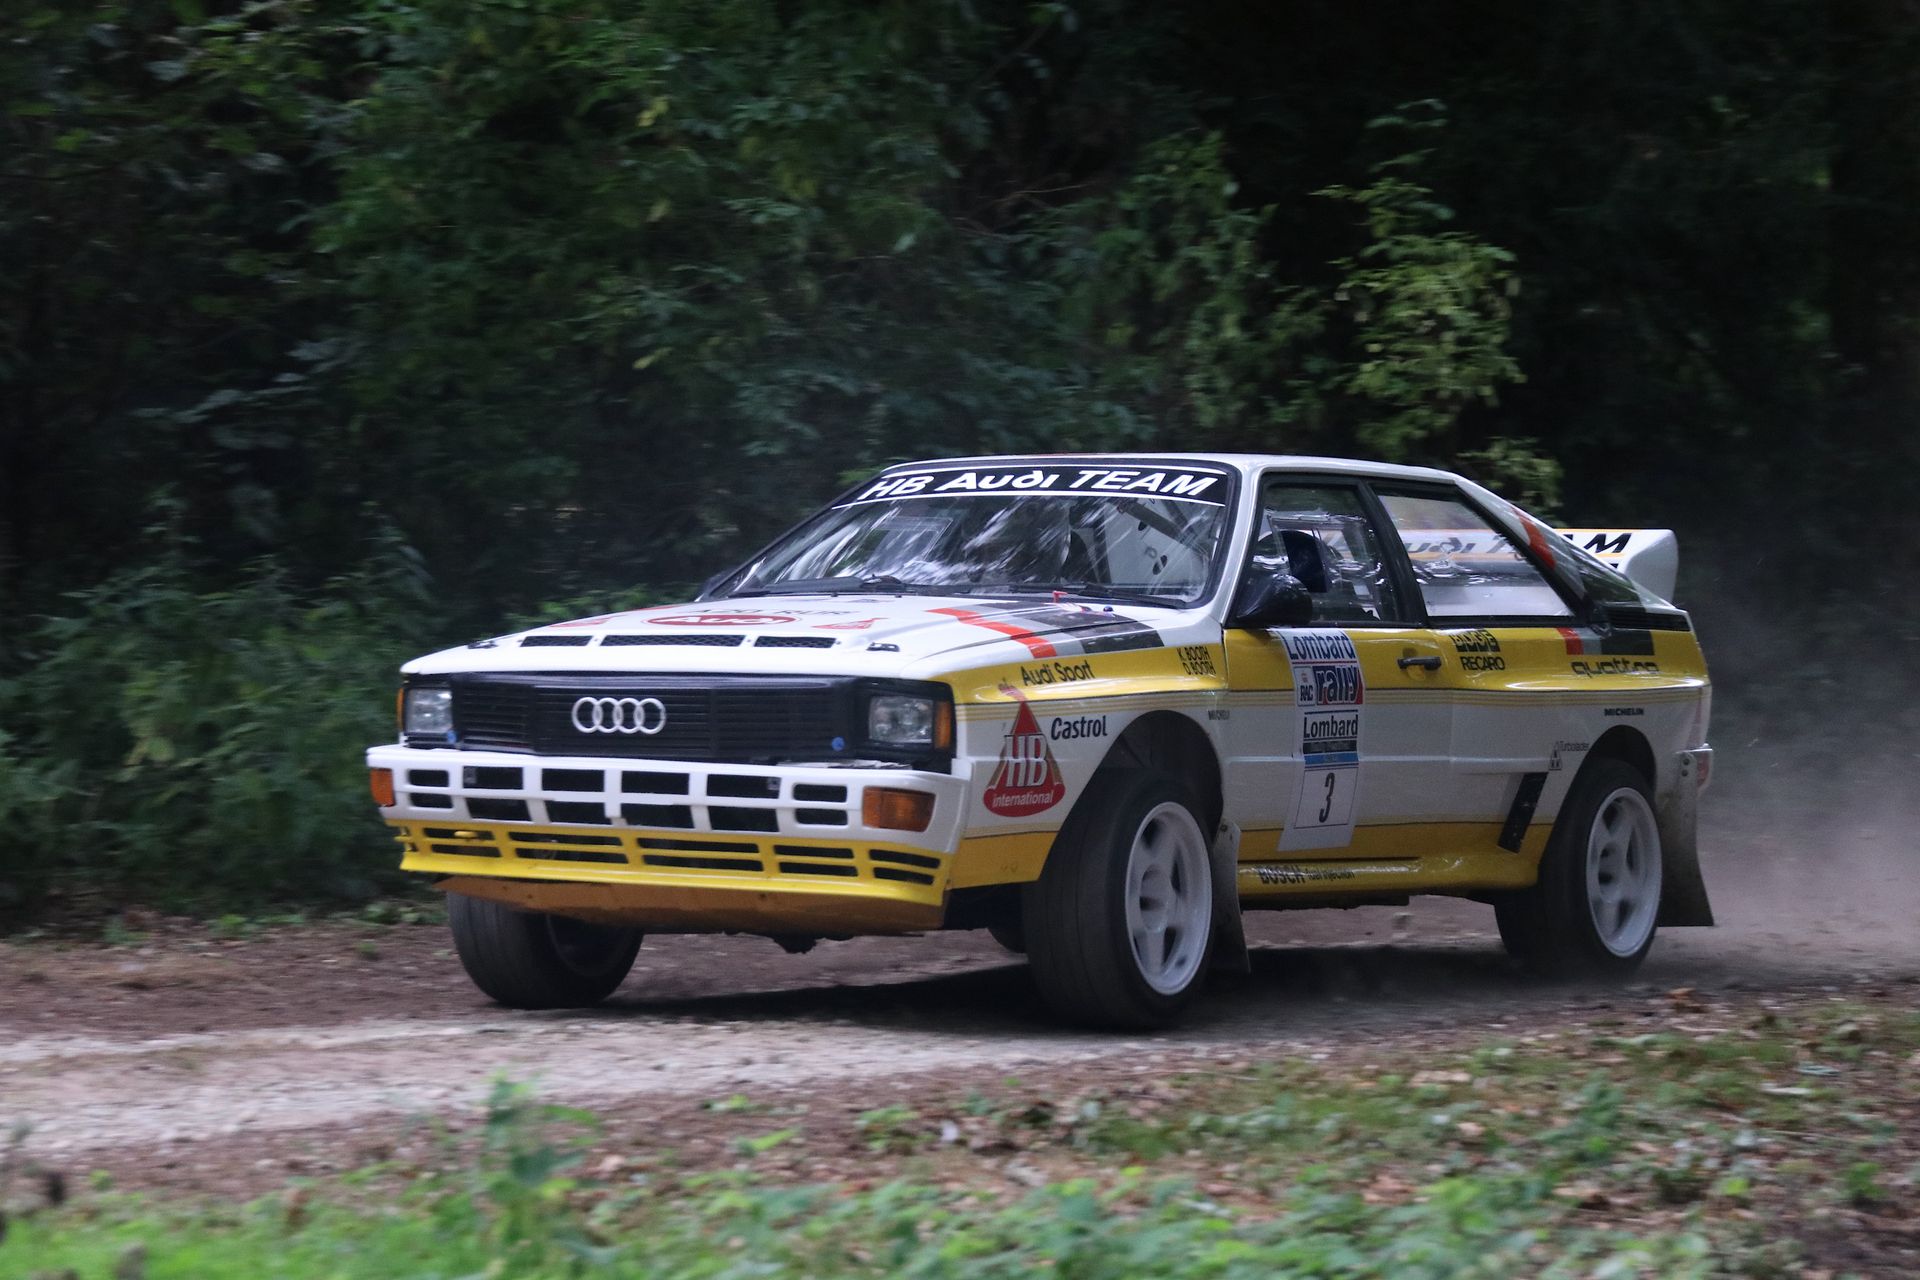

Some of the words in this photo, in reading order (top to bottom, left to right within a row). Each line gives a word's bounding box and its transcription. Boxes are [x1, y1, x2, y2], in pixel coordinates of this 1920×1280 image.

[857, 475, 936, 500] HB
[1069, 470, 1218, 496] TEAM
[1284, 630, 1356, 661] Lombard
[1021, 663, 1055, 686] Audi
[1054, 660, 1096, 682] Sport
[1460, 656, 1506, 671] RECARO
[1570, 657, 1660, 678] quattro
[1300, 684, 1314, 702] RAC
[1315, 665, 1359, 702] rally
[1604, 708, 1645, 717] MICHELIN
[1051, 715, 1108, 740] Castrol
[1303, 714, 1359, 738] Lombard
[1004, 734, 1049, 787] HB
[992, 789, 1054, 808] international
[1318, 772, 1336, 823] 3
[1258, 865, 1306, 885] BOSCH
